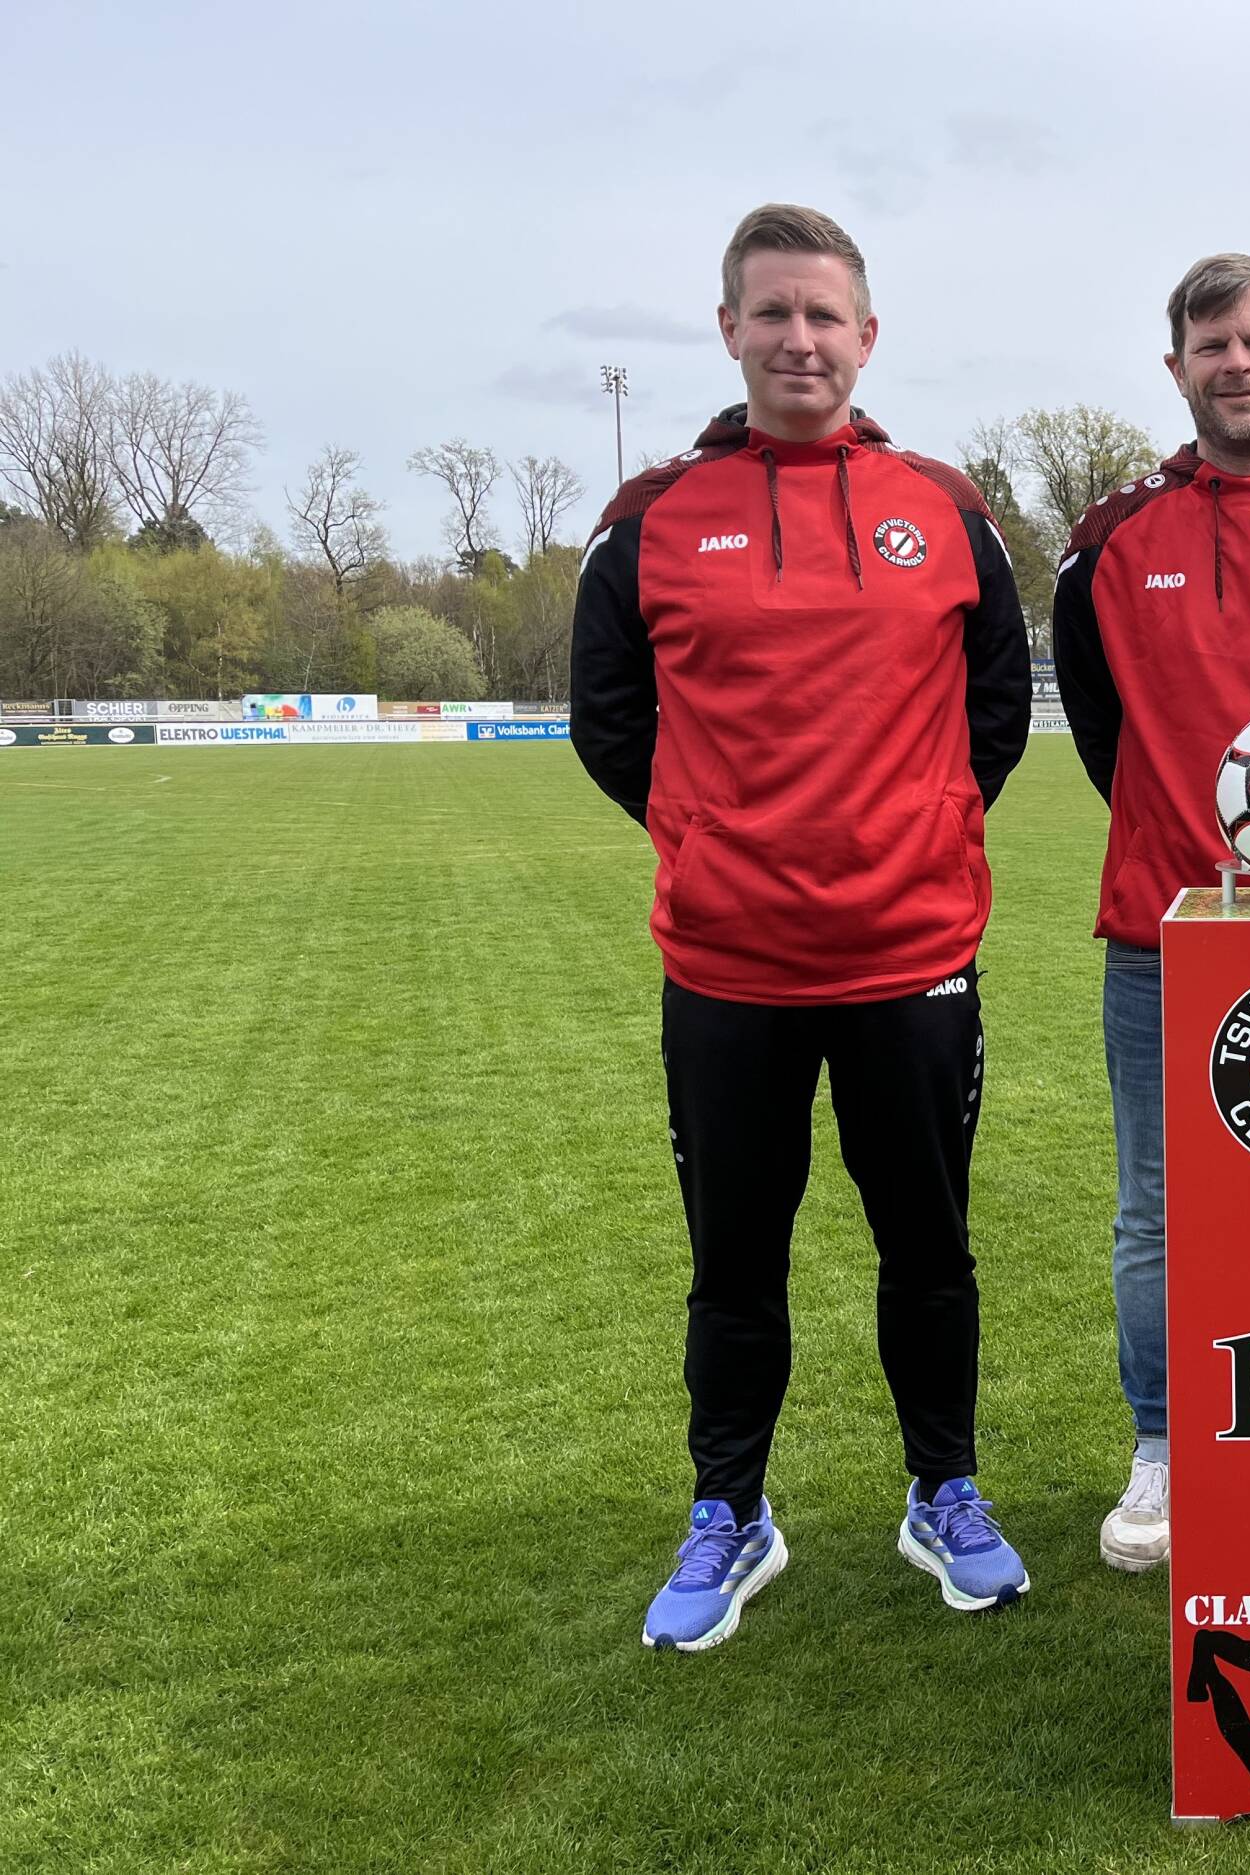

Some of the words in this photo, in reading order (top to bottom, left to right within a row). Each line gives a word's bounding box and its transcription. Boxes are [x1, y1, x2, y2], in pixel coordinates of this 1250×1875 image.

[874, 521, 889, 538] TSV
[886, 518, 926, 546] VICTORIA
[698, 534, 748, 552] JAKO
[878, 546, 925, 566] CLARHOLZ
[1145, 573, 1185, 589] JAKO
[87, 702, 143, 714] SCHIER
[442, 704, 467, 713] AWR
[160, 728, 218, 740] ELEKTRO
[221, 728, 287, 739] WESTPHAL
[292, 724, 357, 732] KAMPMEIER
[497, 726, 546, 735] Volksbank
